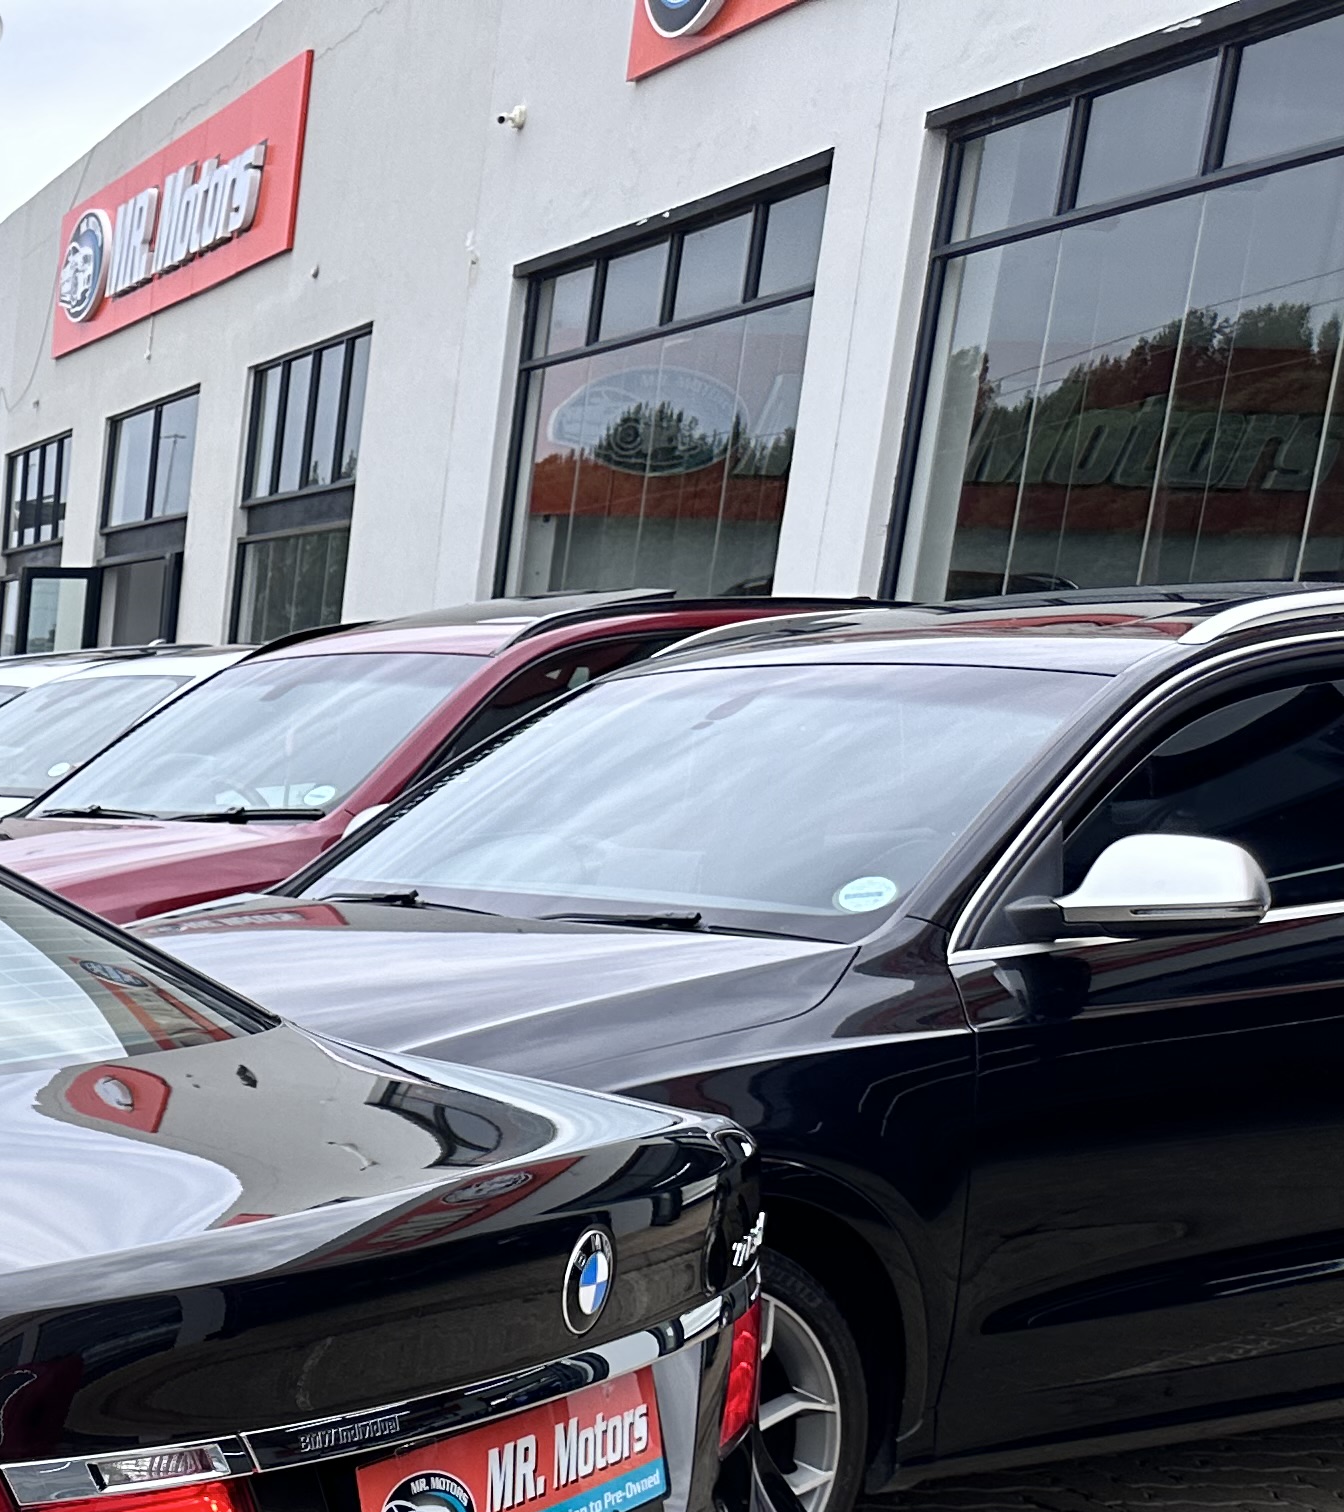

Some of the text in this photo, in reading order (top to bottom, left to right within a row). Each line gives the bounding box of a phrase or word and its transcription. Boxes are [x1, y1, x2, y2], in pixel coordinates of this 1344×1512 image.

[152, 142, 267, 275] Motors
[553, 1403, 649, 1490] Motors
[410, 1476, 469, 1507] MR. MOTORS
[603, 1468, 661, 1510] Pre-Owned
